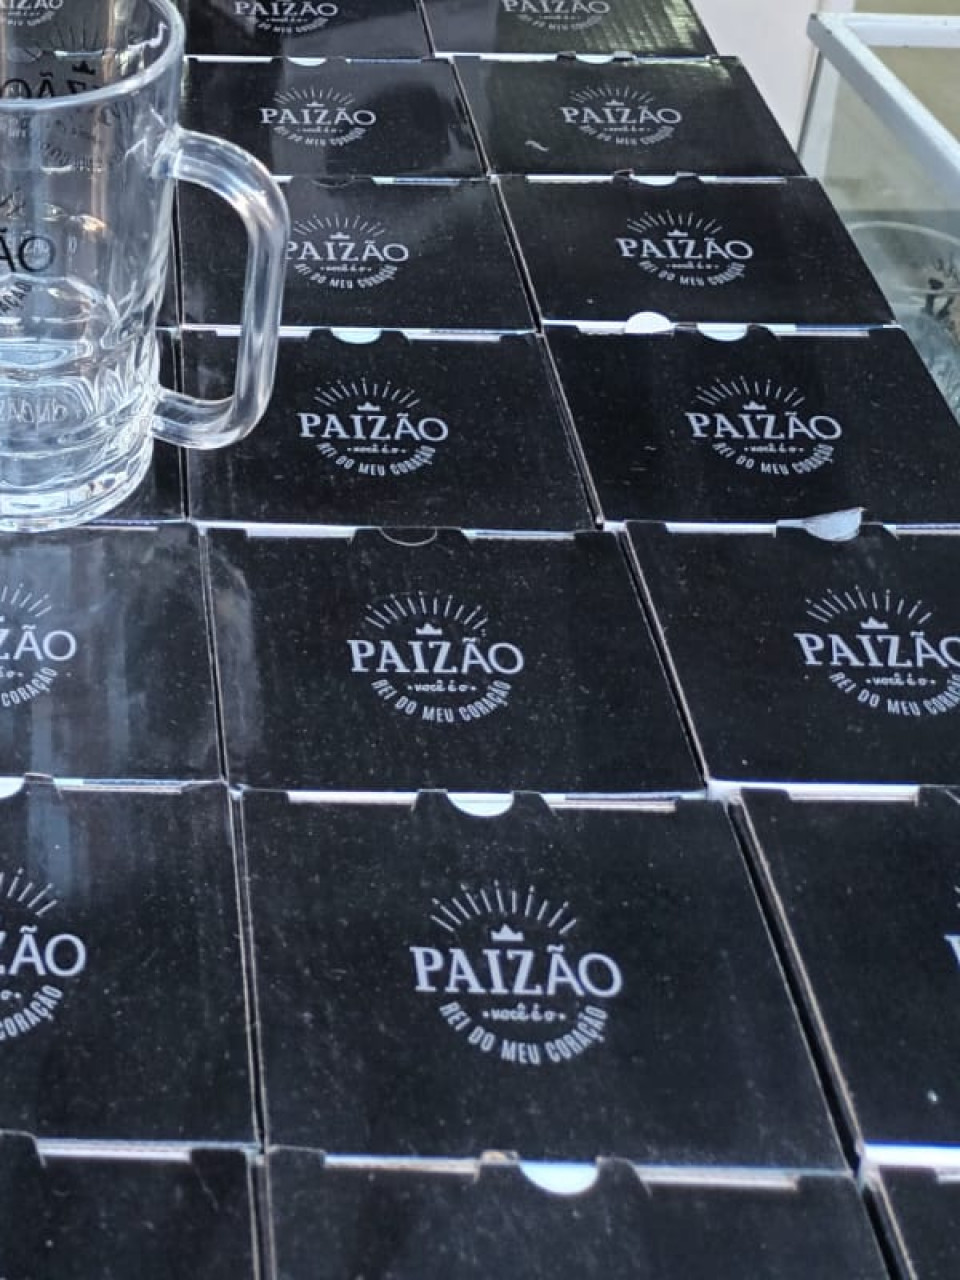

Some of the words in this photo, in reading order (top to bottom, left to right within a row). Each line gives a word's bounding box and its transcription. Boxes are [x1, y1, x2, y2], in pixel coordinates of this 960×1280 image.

[233, 1, 339, 17] PAIZÃO
[260, 107, 377, 126] PAIZÃO
[560, 105, 683, 124] PAIZÃO
[285, 240, 409, 262] PAIZÃO
[615, 237, 754, 260] PAIZÃO
[297, 412, 449, 442] PAIZÃO
[684, 410, 843, 441] PAIZÃO
[347, 636, 525, 675] PAIZÃO
[410, 944, 622, 998] PAIZÃO
[440, 1001, 471, 1031] REI
[468, 1025, 495, 1052] DO
[500, 1039, 541, 1066] MEU
[544, 1005, 608, 1063] CORAÇÃO
